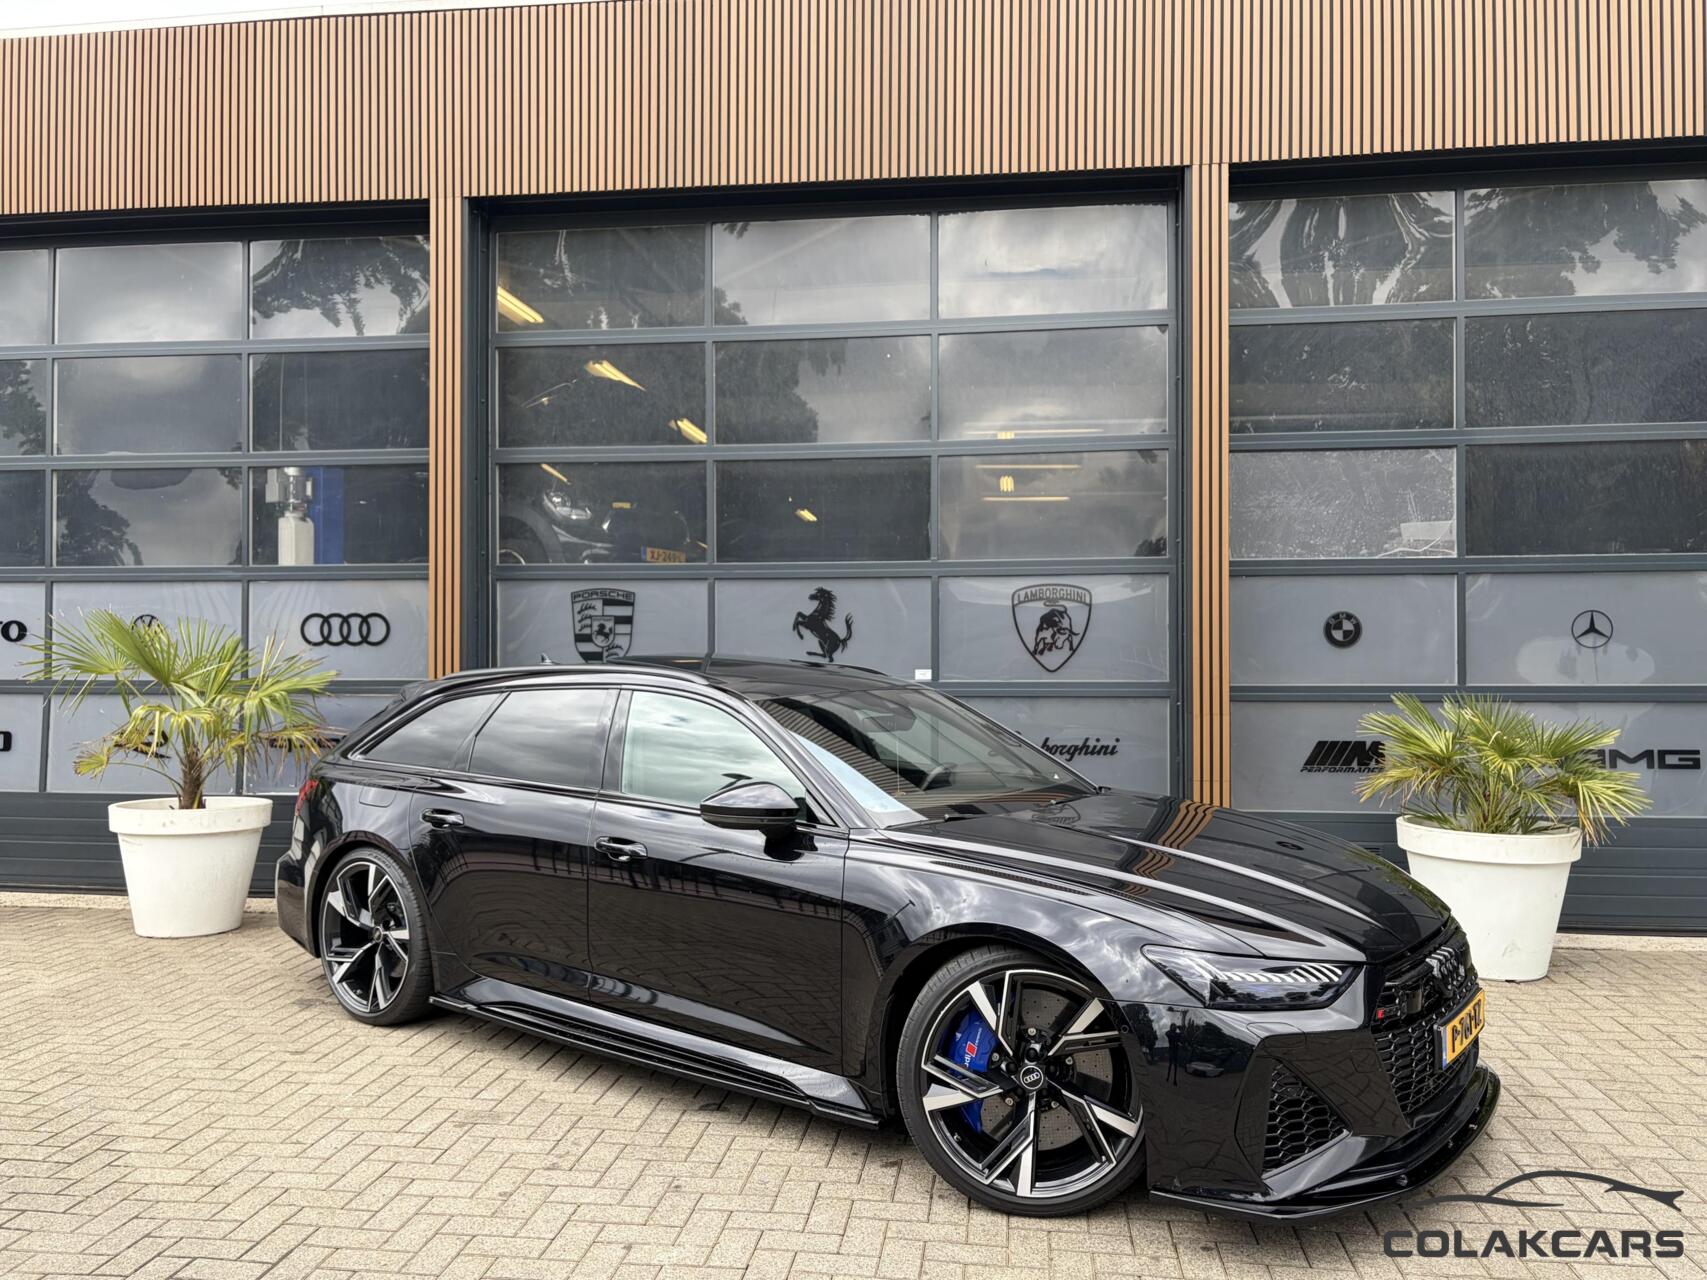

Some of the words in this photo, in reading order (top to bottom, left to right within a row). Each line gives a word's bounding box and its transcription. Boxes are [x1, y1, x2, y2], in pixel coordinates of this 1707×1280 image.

[573, 590, 634, 601] PORSCHE
[1017, 587, 1087, 604] LAMBORGHINI
[1041, 737, 1120, 762] borghini
